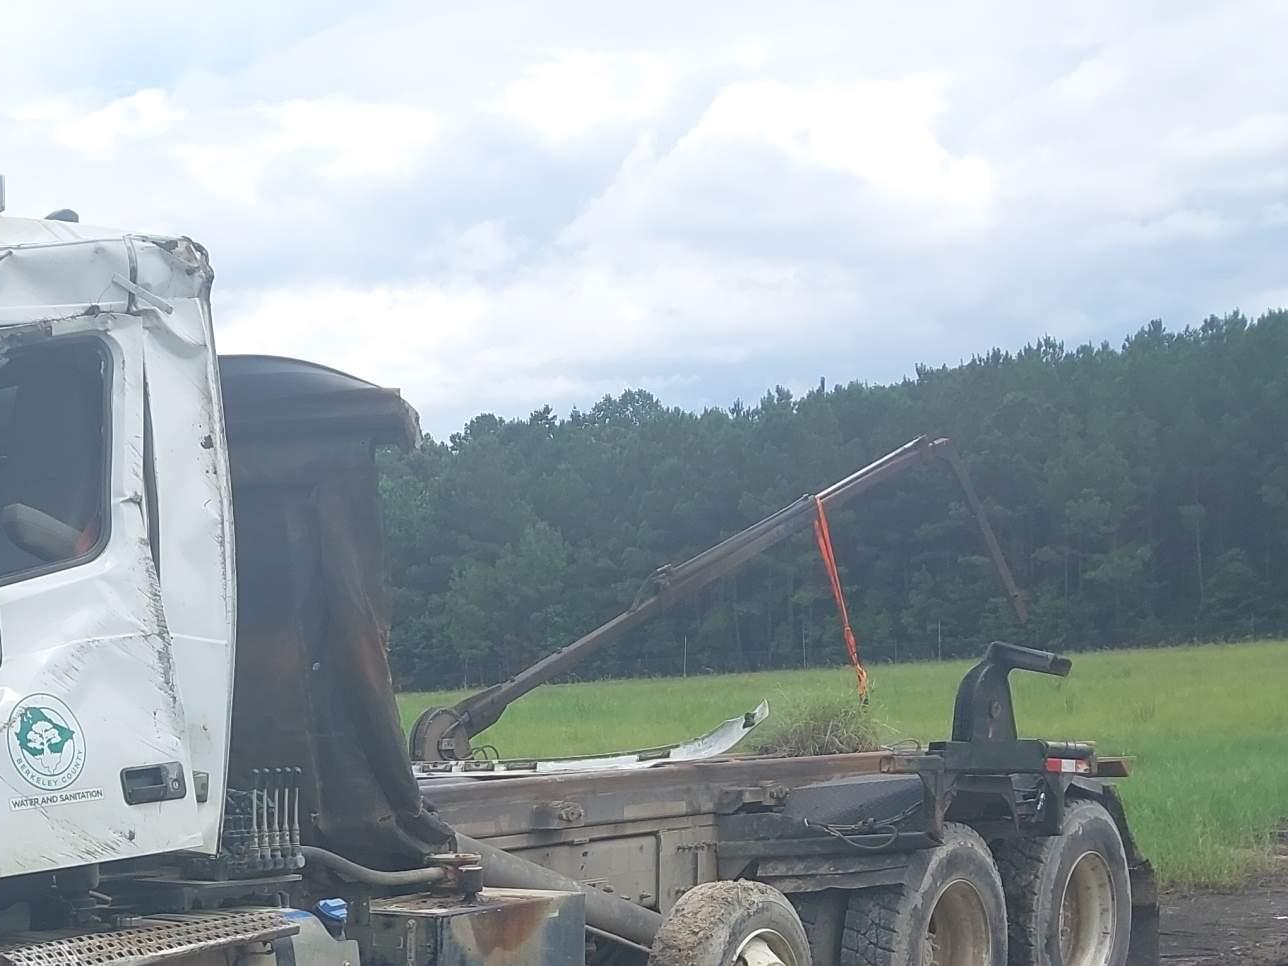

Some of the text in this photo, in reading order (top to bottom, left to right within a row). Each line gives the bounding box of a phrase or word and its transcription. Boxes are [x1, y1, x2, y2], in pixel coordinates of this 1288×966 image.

[16, 750, 83, 787] BERKELEY COUNTY
[11, 790, 103, 809] WATER AND SANITATION
